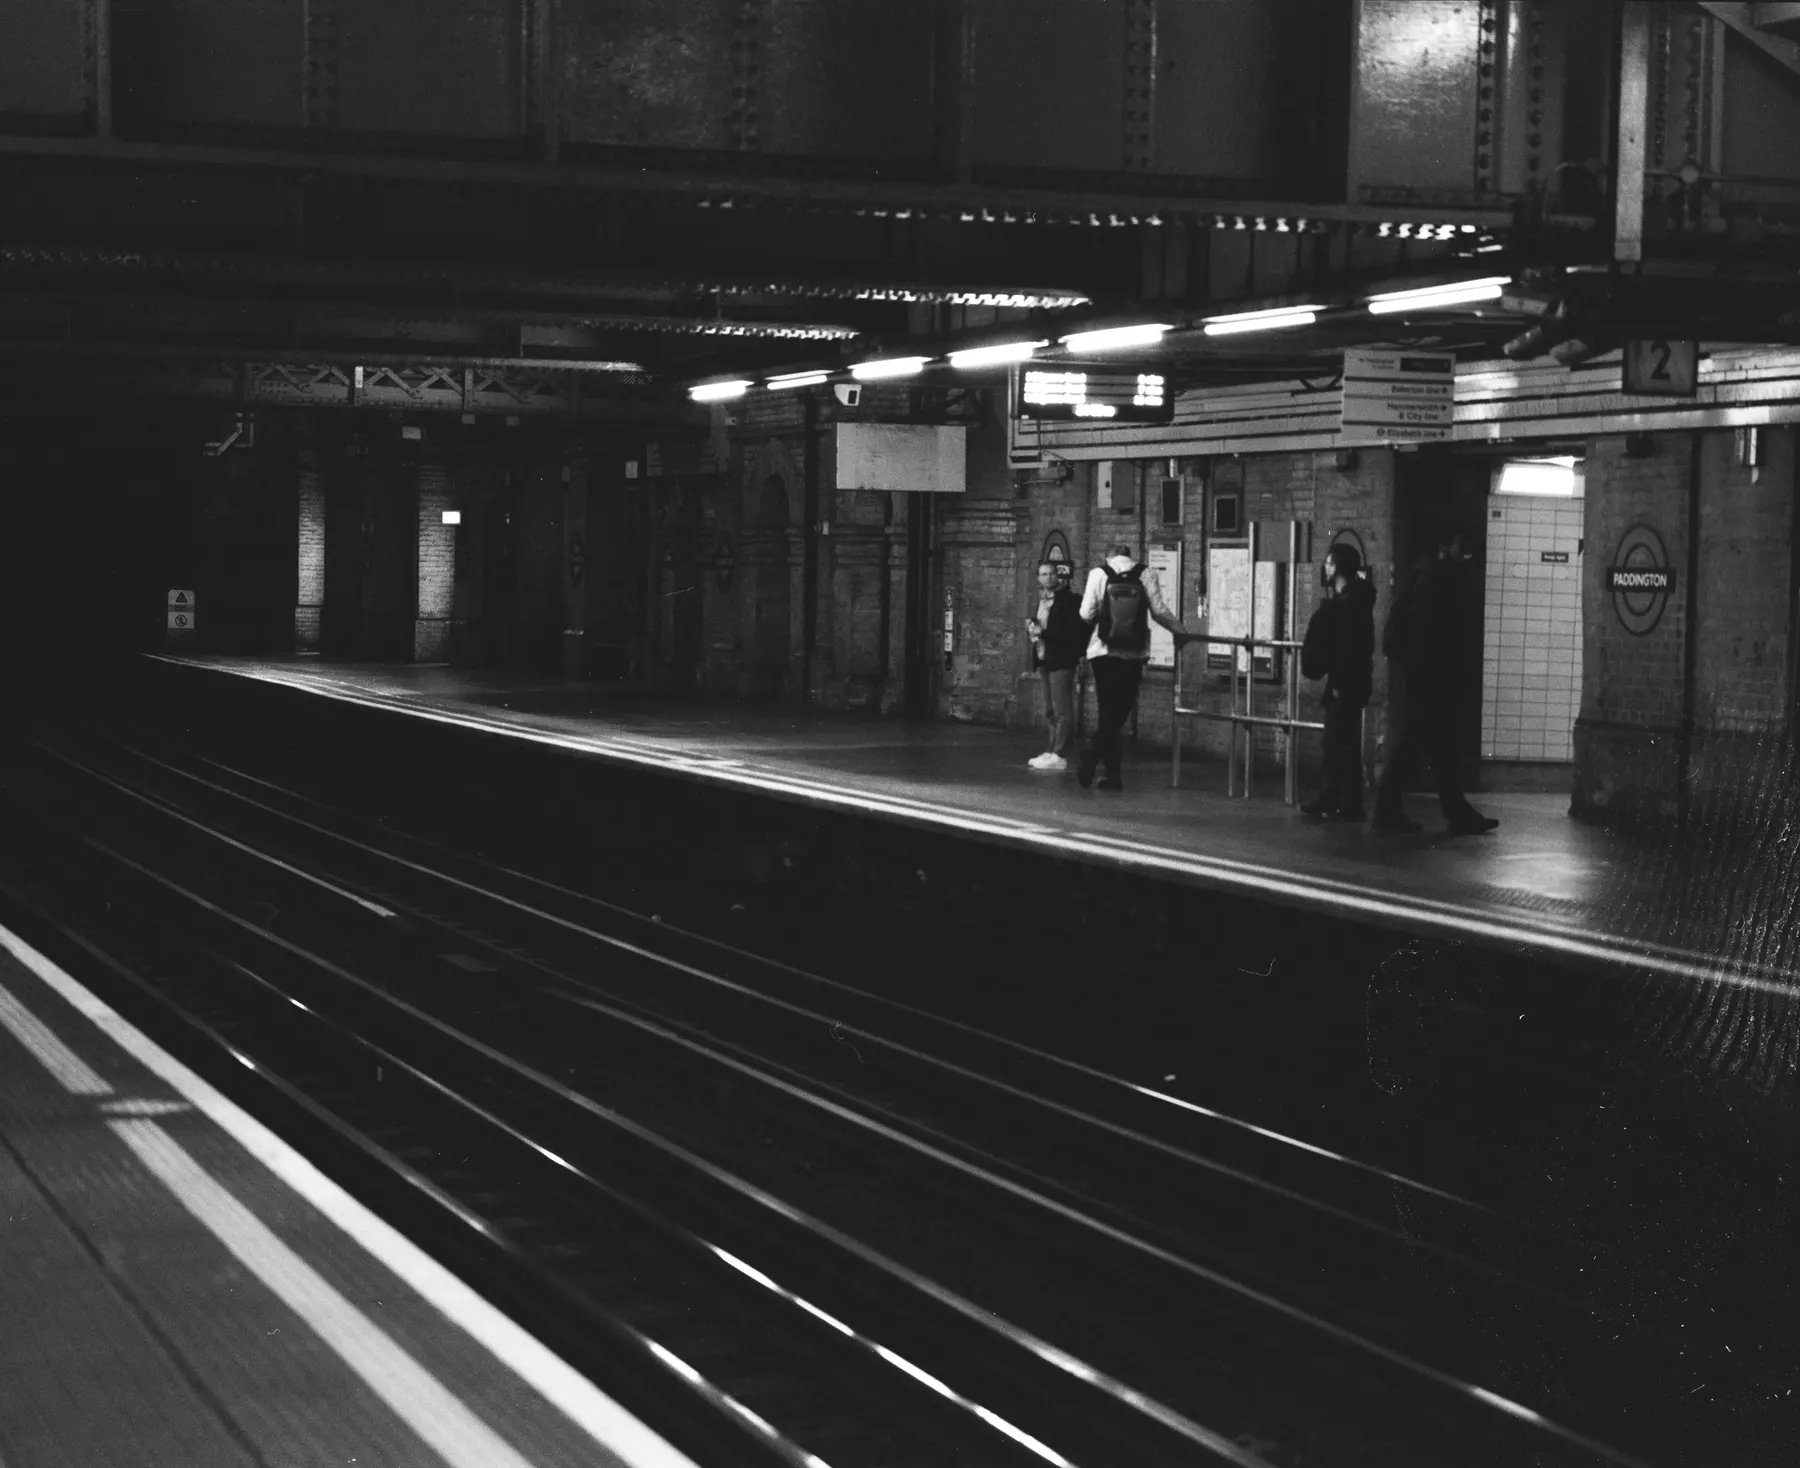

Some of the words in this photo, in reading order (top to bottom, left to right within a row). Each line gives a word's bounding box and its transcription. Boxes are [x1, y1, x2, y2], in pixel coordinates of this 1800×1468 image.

[1651, 340, 1672, 380] 2
[1425, 386, 1440, 394] line
[1387, 403, 1439, 411] Hammersmith
[1406, 412, 1422, 421] City
[1424, 412, 1438, 420] line
[1387, 428, 1422, 437] Elizabeth
[1423, 430, 1437, 438] line
[1613, 572, 1667, 587] PADDINGTON
